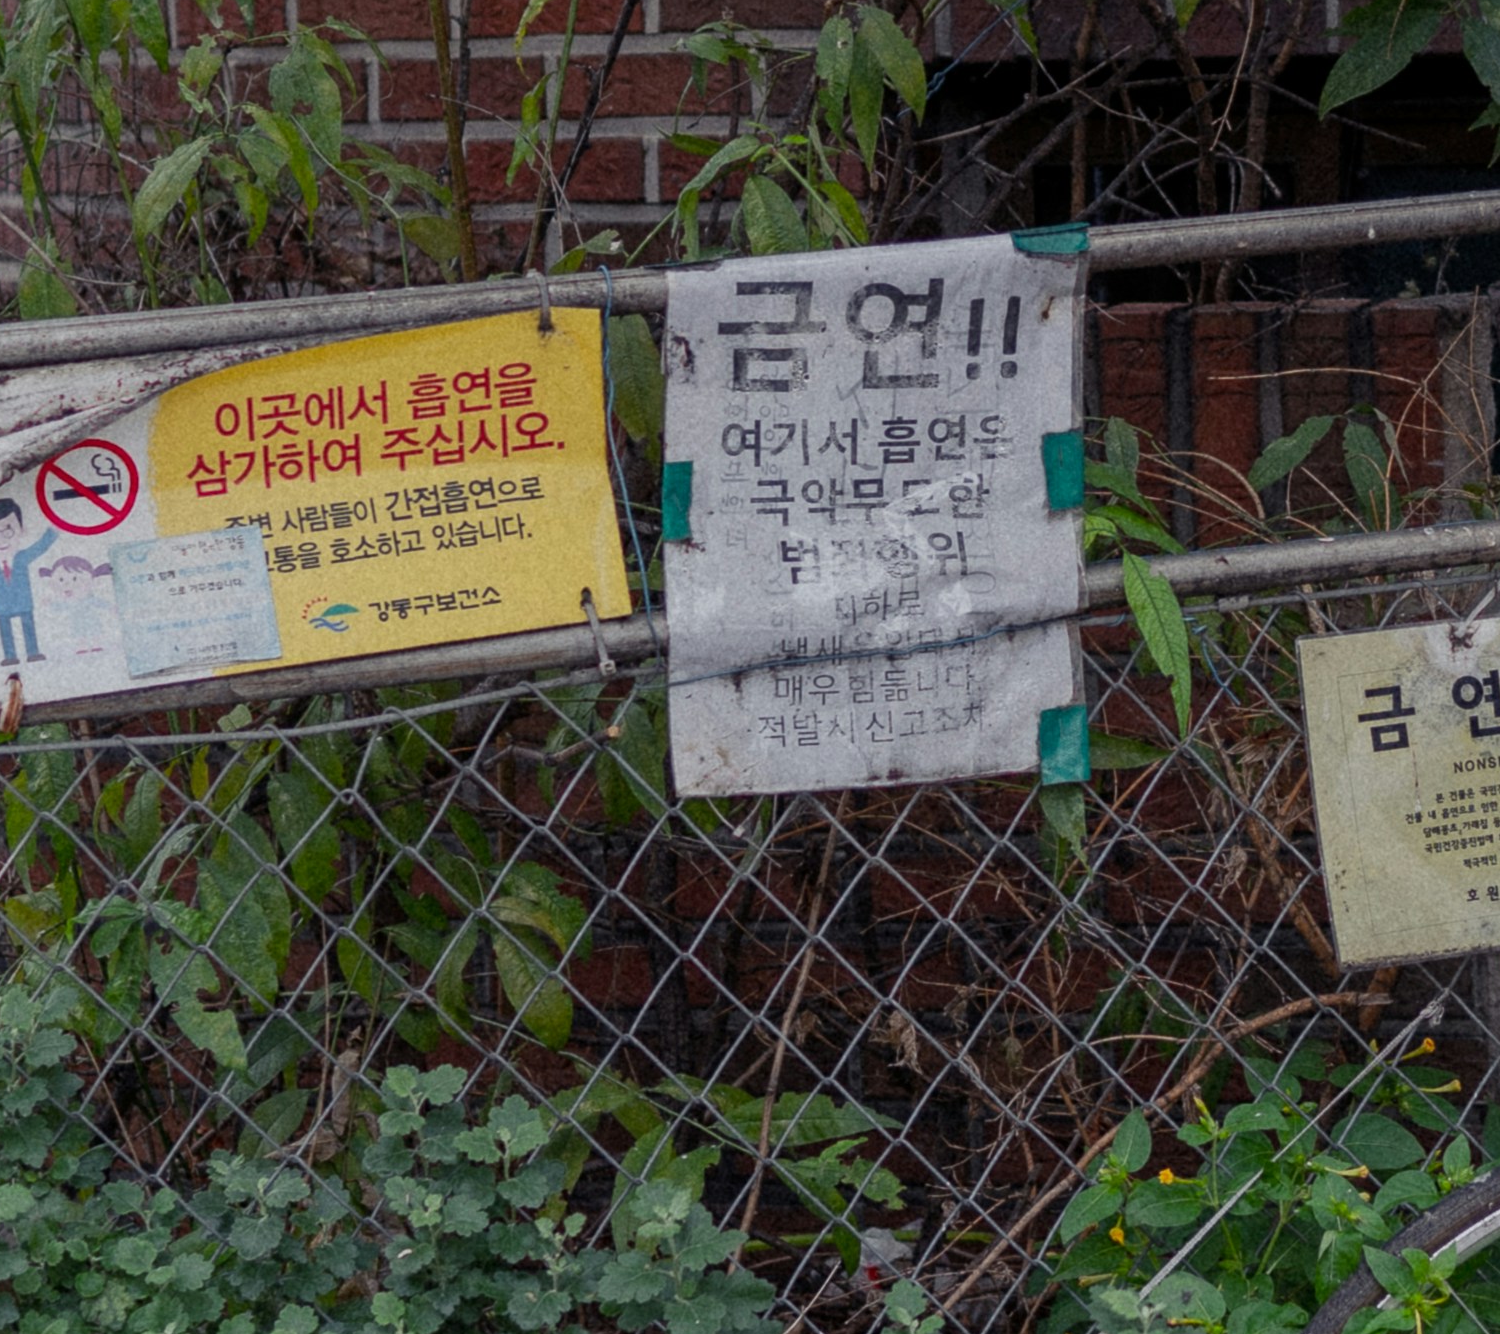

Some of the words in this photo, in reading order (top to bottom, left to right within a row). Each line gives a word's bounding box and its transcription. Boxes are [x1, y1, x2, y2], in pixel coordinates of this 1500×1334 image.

[214, 380, 390, 443] 이곳에서
[406, 362, 538, 418] 흡연을
[187, 434, 363, 498] 삼가하여
[380, 411, 566, 472] 주십시오.
[721, 418, 858, 467] 여기서
[283, 498, 378, 534] 사람들이
[385, 475, 544, 521] 간접흡연으로
[330, 528, 426, 566] 호소하고
[432, 513, 534, 548] 있습니다.
[369, 586, 503, 623] 강동구보건소
